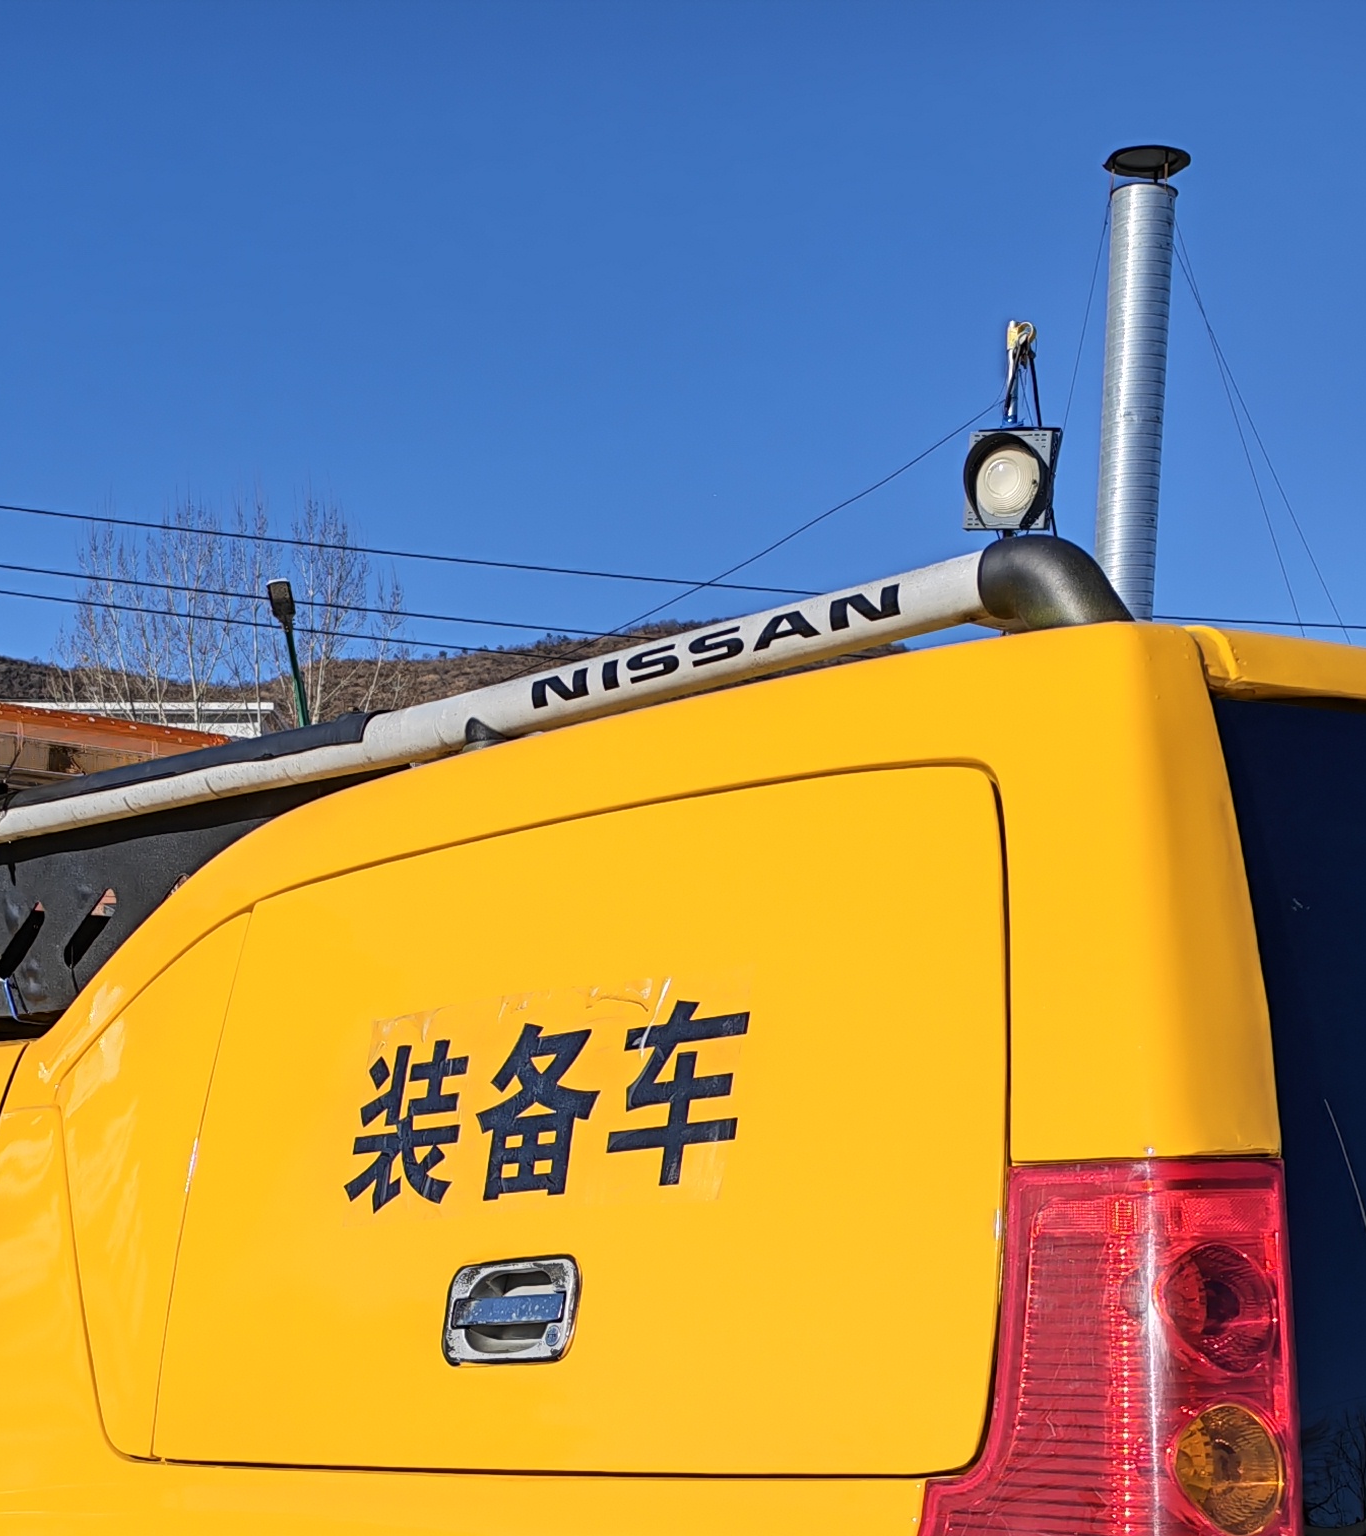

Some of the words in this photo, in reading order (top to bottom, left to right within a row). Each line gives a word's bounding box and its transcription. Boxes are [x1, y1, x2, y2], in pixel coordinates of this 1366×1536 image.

[532, 583, 901, 709] NISSAN
[343, 1000, 750, 1214] 装备车
